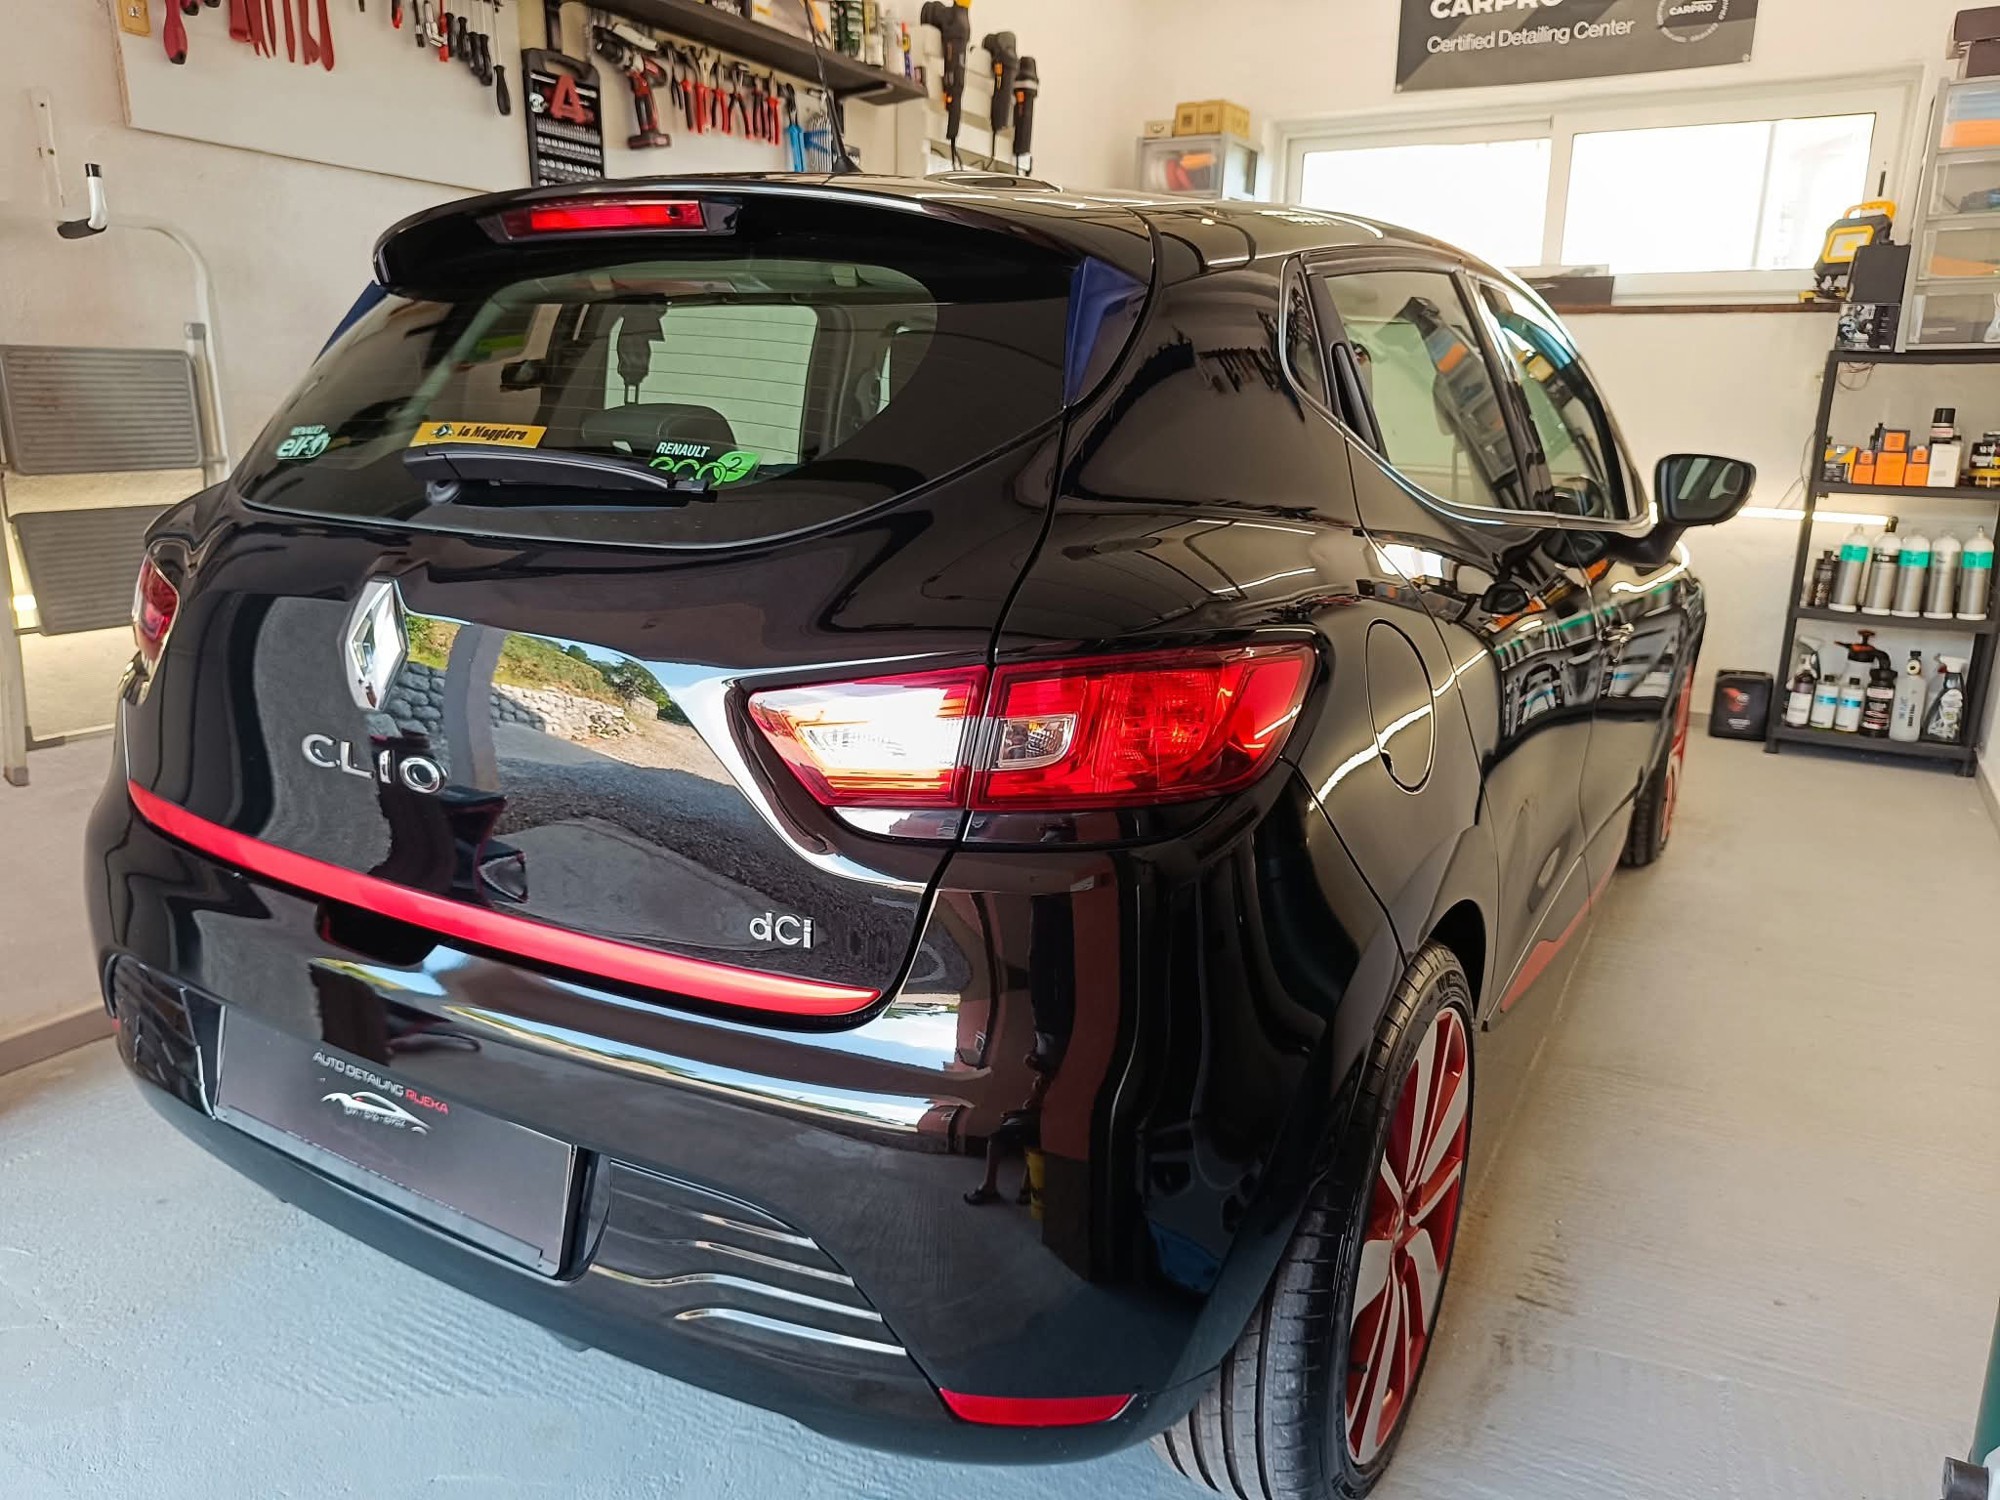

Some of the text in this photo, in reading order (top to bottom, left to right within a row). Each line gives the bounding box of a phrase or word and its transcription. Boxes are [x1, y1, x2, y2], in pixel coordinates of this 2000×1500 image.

[1426, 31, 1496, 54] Certified
[1498, 25, 1571, 48] Detailing
[1573, 19, 1636, 39] Center
[656, 441, 710, 458] RENAULT
[301, 733, 441, 794] CLIO
[749, 912, 812, 949] dCi
[312, 1051, 345, 1073] AUTO
[344, 1064, 404, 1098] DETAILING
